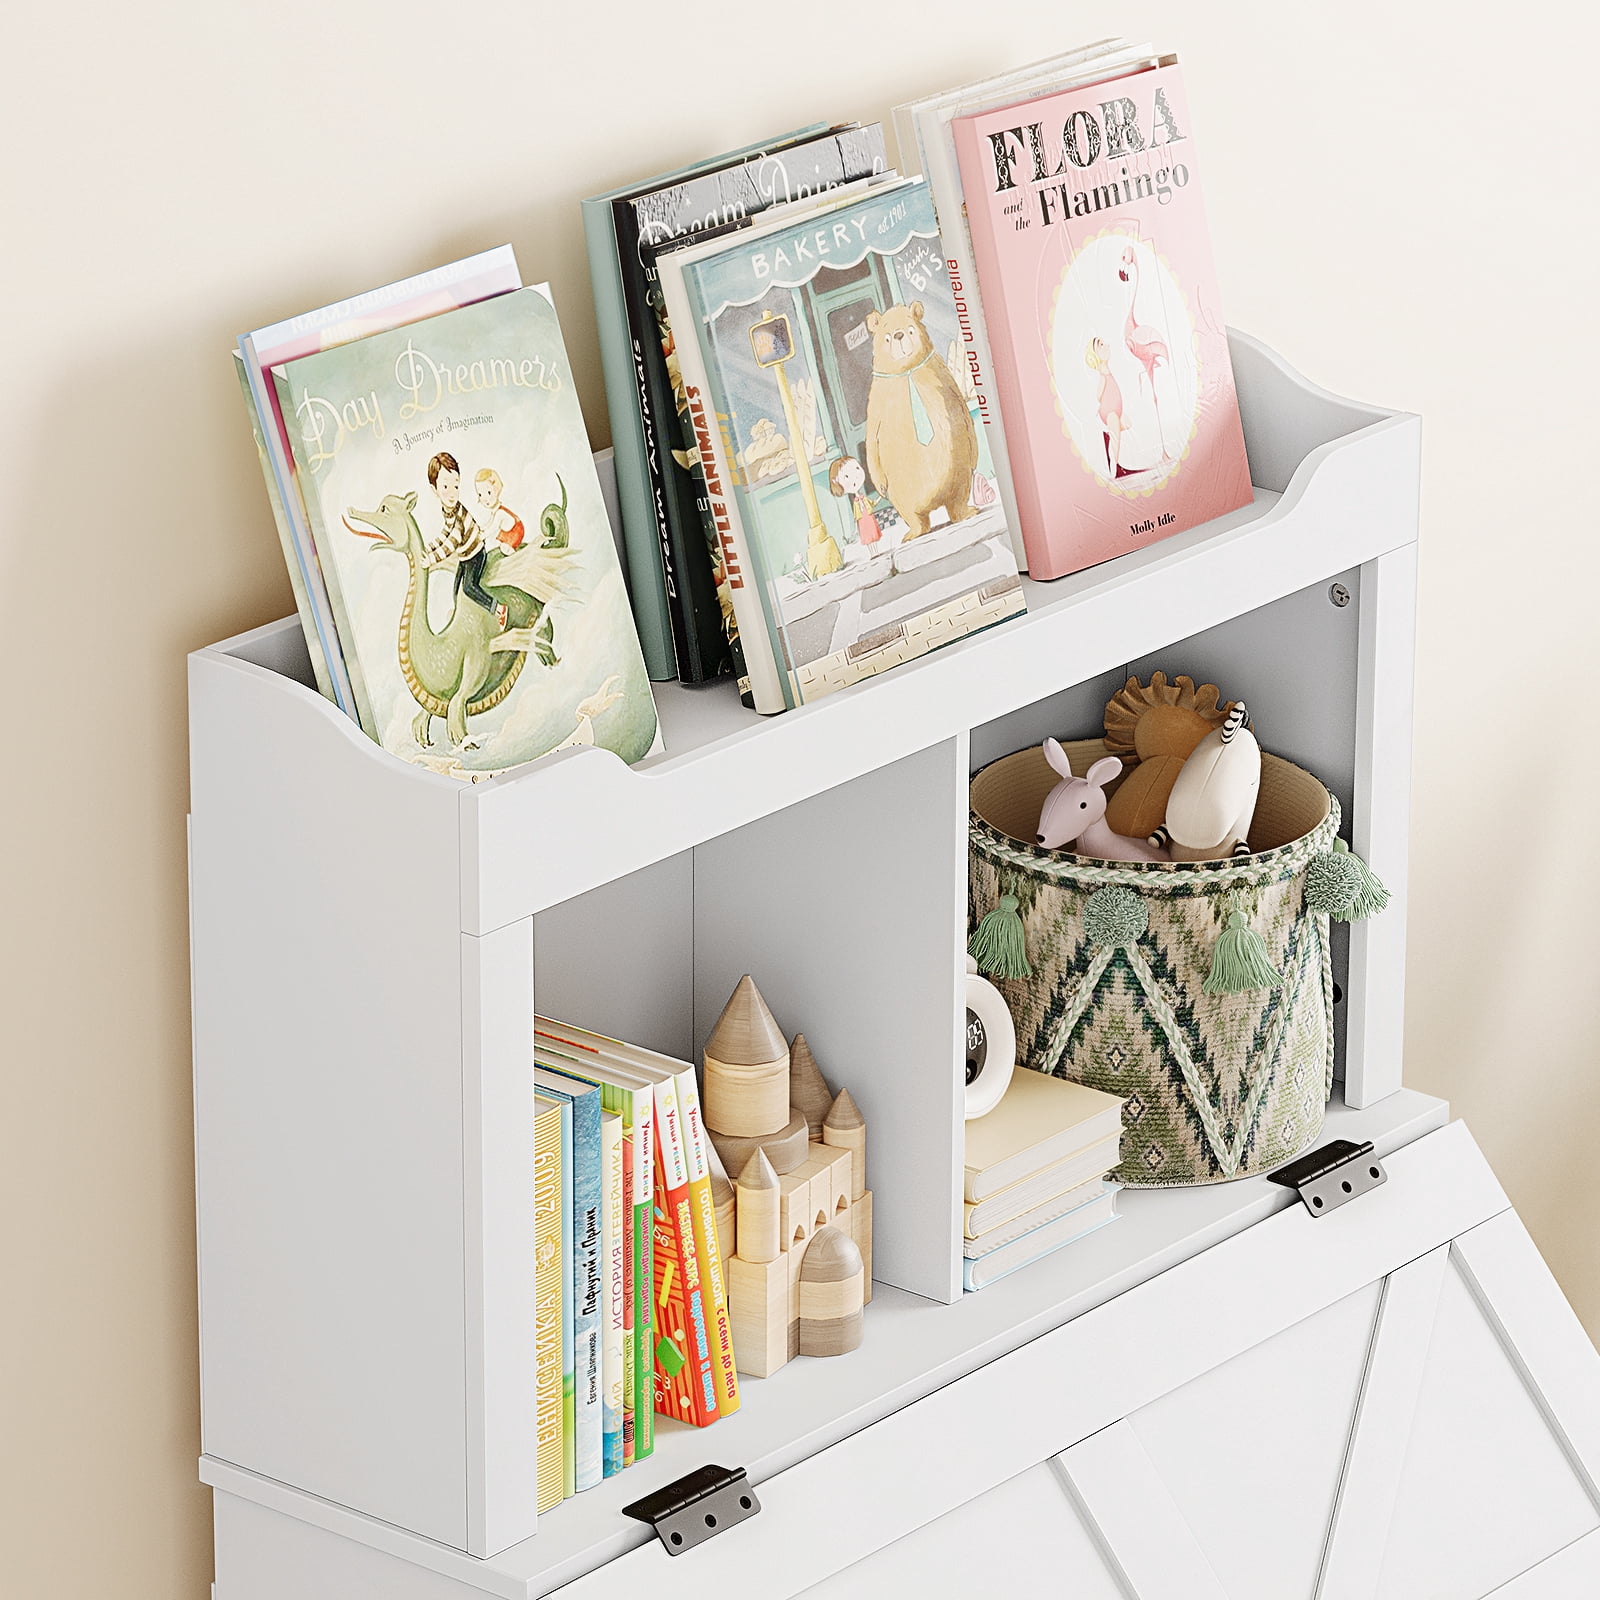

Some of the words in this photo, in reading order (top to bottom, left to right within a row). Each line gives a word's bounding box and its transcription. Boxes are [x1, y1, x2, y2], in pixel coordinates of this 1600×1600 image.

[985, 87, 1187, 193] FLORA
[1003, 198, 1024, 216] and
[1015, 216, 1031, 231] the
[1036, 162, 1190, 228] Flamingo
[751, 215, 869, 279] BAKERY
[888, 200, 908, 230] 1901
[295, 386, 385, 474] Day
[394, 338, 563, 420] Dreamers
[632, 338, 660, 475] Animals
[392, 438, 403, 454] A
[404, 429, 436, 450] Journey
[436, 420, 444, 436] of
[447, 414, 494, 431] Imagination
[686, 384, 725, 497] ANIMALS
[655, 487, 678, 599] Dream
[713, 501, 746, 590] LITTLE
[1129, 519, 1156, 537] Molly
[1157, 512, 1177, 527] Idle
[535, 1151, 556, 1221] 2009
[625, 1190, 634, 1226] Famous
[581, 1206, 602, 1249] Пряник
[641, 1206, 650, 1275] ЭНЦИКЛОПЕДИЯ
[699, 1187, 717, 1257] ГОТОВИМСЯ
[588, 1248, 596, 1257] и
[625, 1228, 634, 1277] Adventures
[582, 1256, 600, 1317] Пафнутий
[612, 1246, 623, 1331] ИСТОРИЯ
[624, 1291, 634, 1311] Jack
[709, 1263, 724, 1307] ШКОЛЕ
[586, 1331, 597, 1376] Шляпникова
[690, 1290, 709, 1361] подготовки
[702, 1370, 717, 1412] школе
[717, 1316, 729, 1352] осени
[720, 1353, 732, 1369] до
[587, 1375, 597, 1405] Евгения
[725, 1369, 736, 1399] лета
